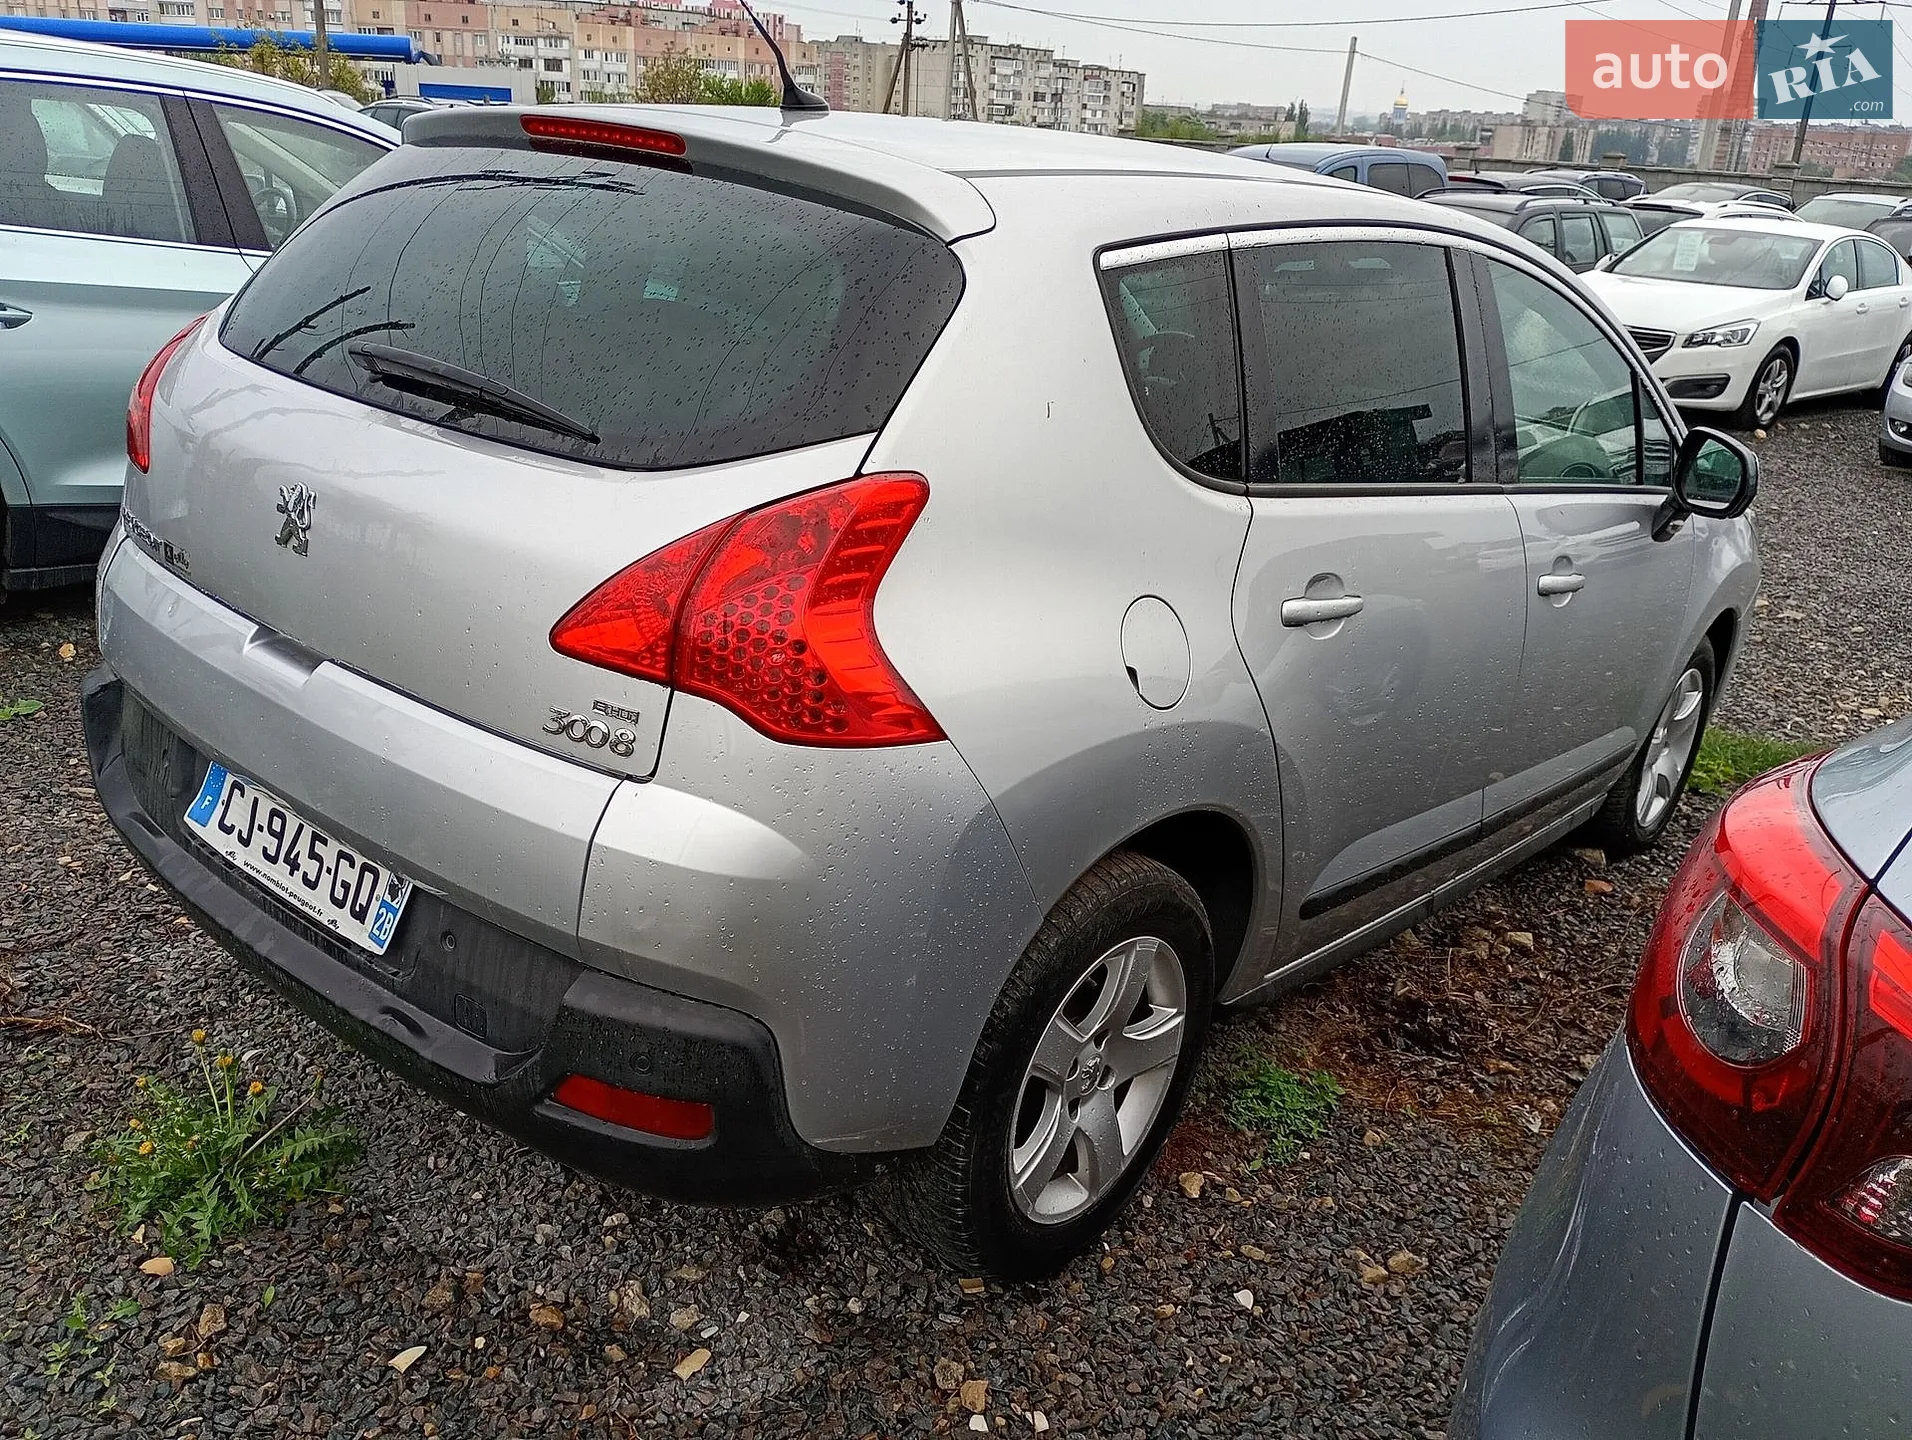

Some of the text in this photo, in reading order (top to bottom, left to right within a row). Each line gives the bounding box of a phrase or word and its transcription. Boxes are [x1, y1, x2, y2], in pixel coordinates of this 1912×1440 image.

[542, 705, 637, 758] 3008
[201, 796, 213, 810] F
[217, 780, 380, 925] CJ-945-GQ
[372, 907, 394, 941] 2B
